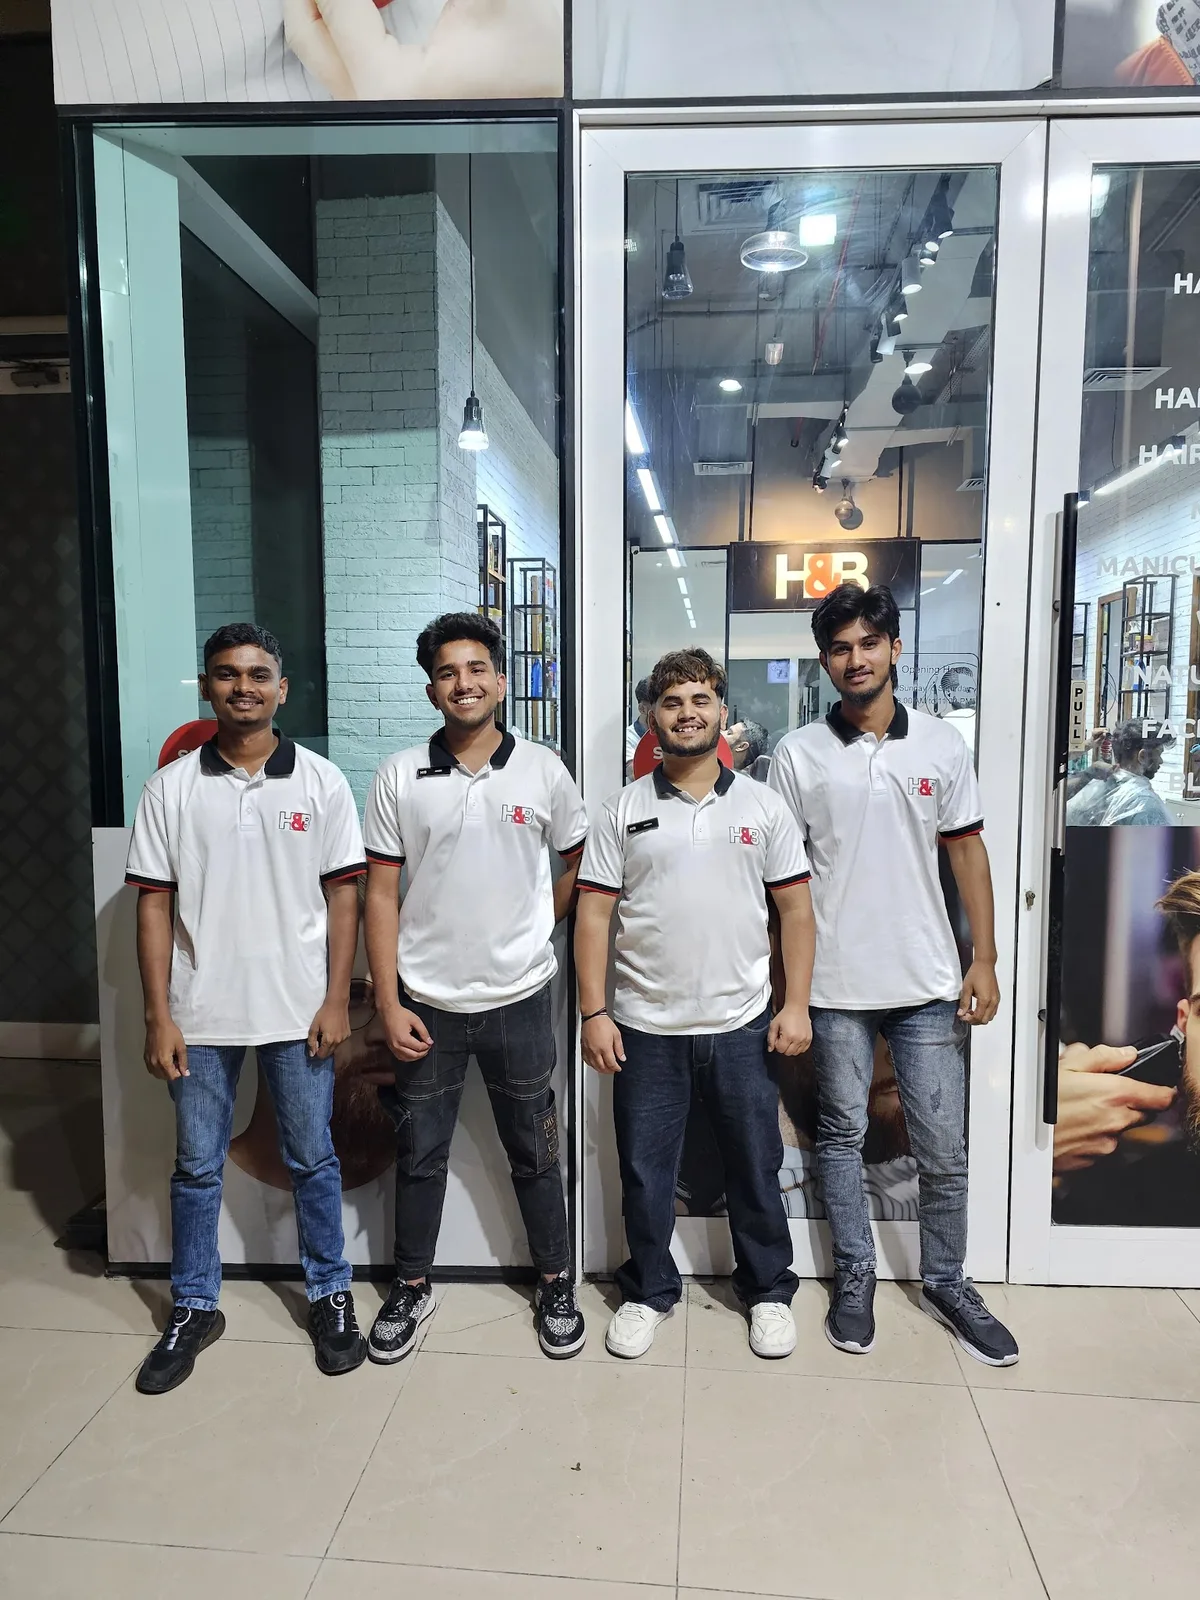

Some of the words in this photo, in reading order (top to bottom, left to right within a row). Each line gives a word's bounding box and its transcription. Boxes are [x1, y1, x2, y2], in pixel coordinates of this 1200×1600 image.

[775, 552, 870, 600] H&B
[901, 664, 939, 675] Opening
[1073, 687, 1084, 739] PULL
[278, 811, 312, 832] H&B
[501, 804, 535, 825] H&B
[729, 826, 761, 846] H&B
